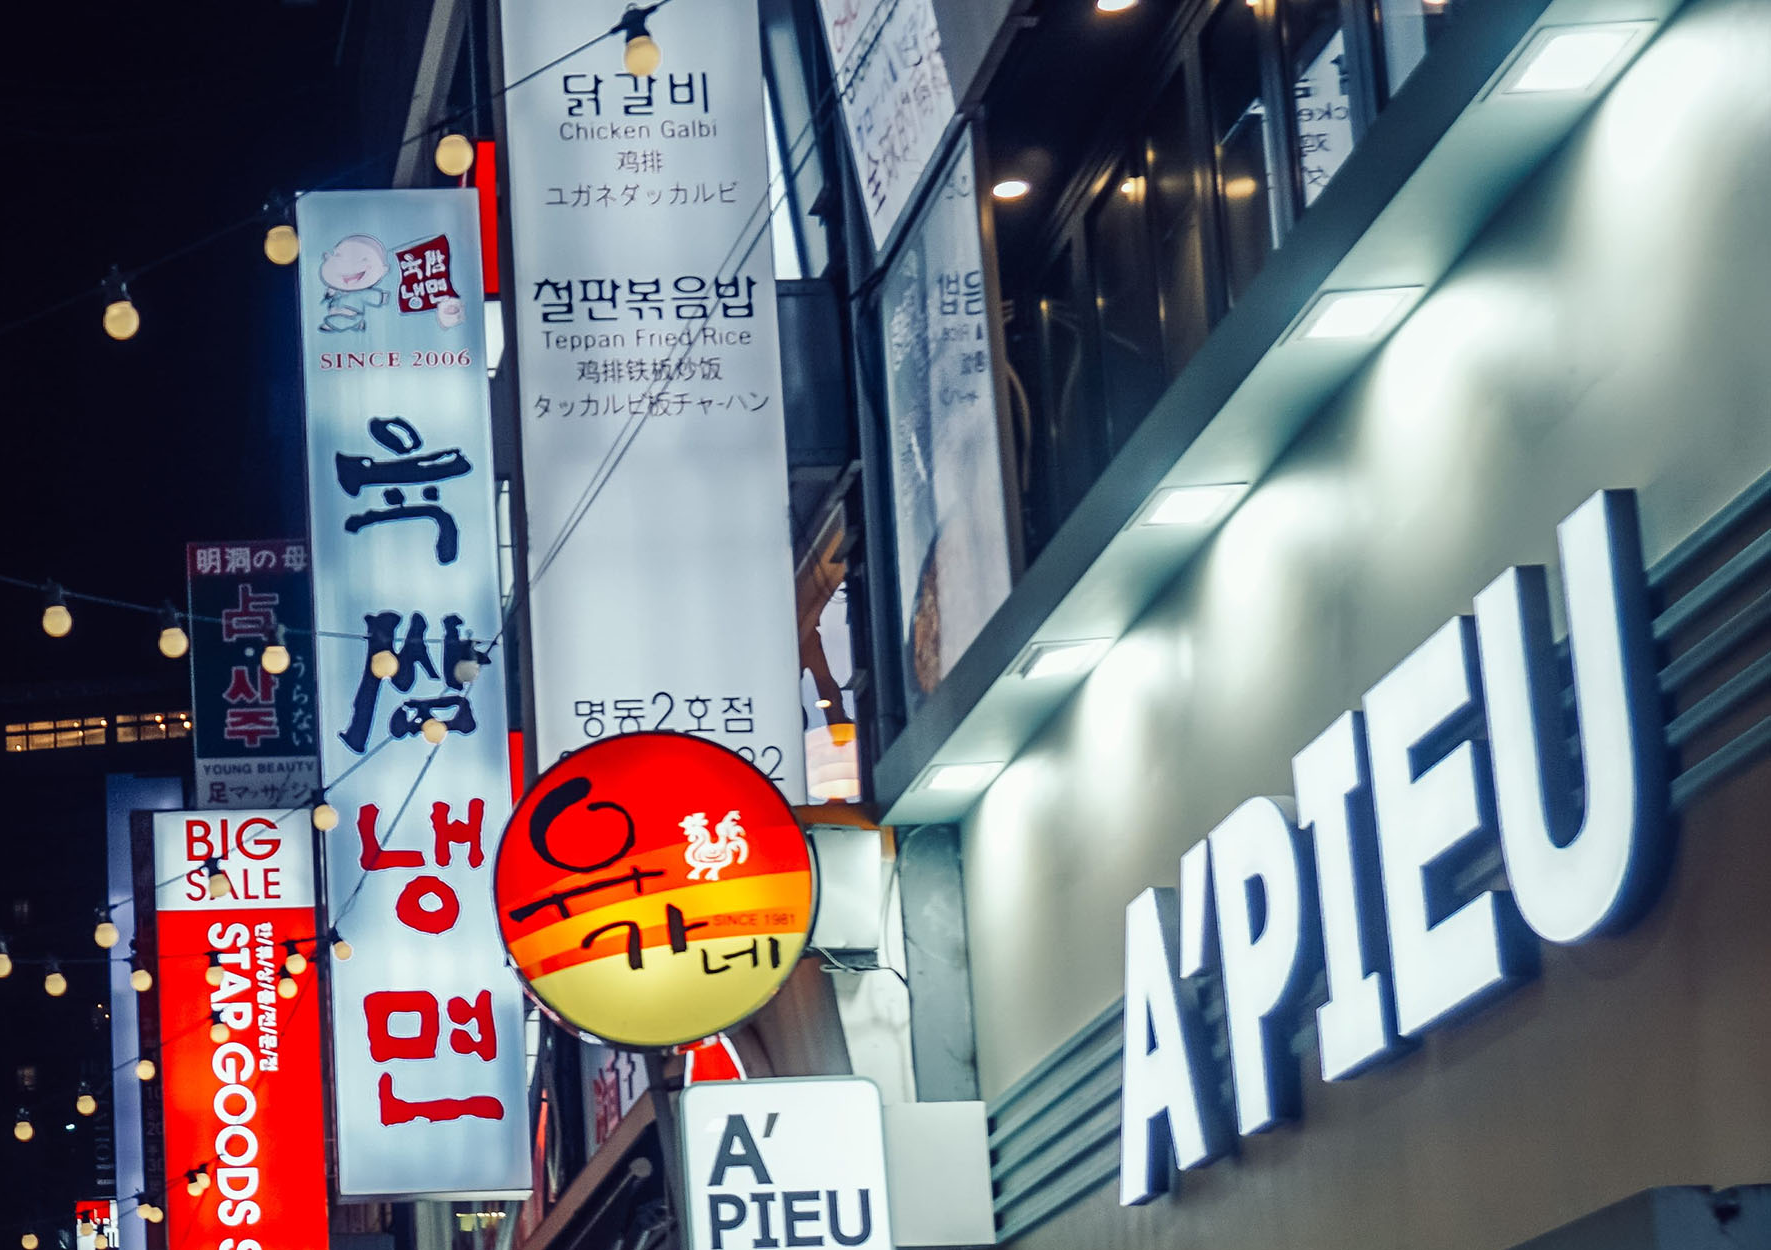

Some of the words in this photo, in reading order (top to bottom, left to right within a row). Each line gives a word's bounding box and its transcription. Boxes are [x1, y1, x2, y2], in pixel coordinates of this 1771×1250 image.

[562, 71, 710, 117] 닭갈비
[559, 120, 650, 140] Chicken
[661, 119, 717, 138] Galbi
[616, 150, 663, 173] 鸡排
[545, 181, 738, 208] ユガネダッカルビ
[534, 275, 757, 323] 철판볶음밥
[542, 331, 625, 350] Teppan
[636, 330, 692, 348] Fried
[702, 328, 751, 346] Rice
[320, 351, 402, 369] SINCE
[412, 348, 472, 368] 2006
[196, 546, 307, 574] 明洞の母
[575, 692, 753, 737] 명동2호점
[203, 763, 253, 775] YOUNG
[258, 762, 314, 774] BEAUTY
[336, 416, 504, 1127] 육쌈냉면
[186, 818, 281, 860] BIG
[1119, 488, 1637, 1206] A'PIEU
[186, 868, 281, 901] SALE
[509, 777, 780, 975] 유가네
[713, 913, 757, 926] SINCE
[211, 1042, 260, 1226] GOODS
[709, 1188, 873, 1250] PIEU
